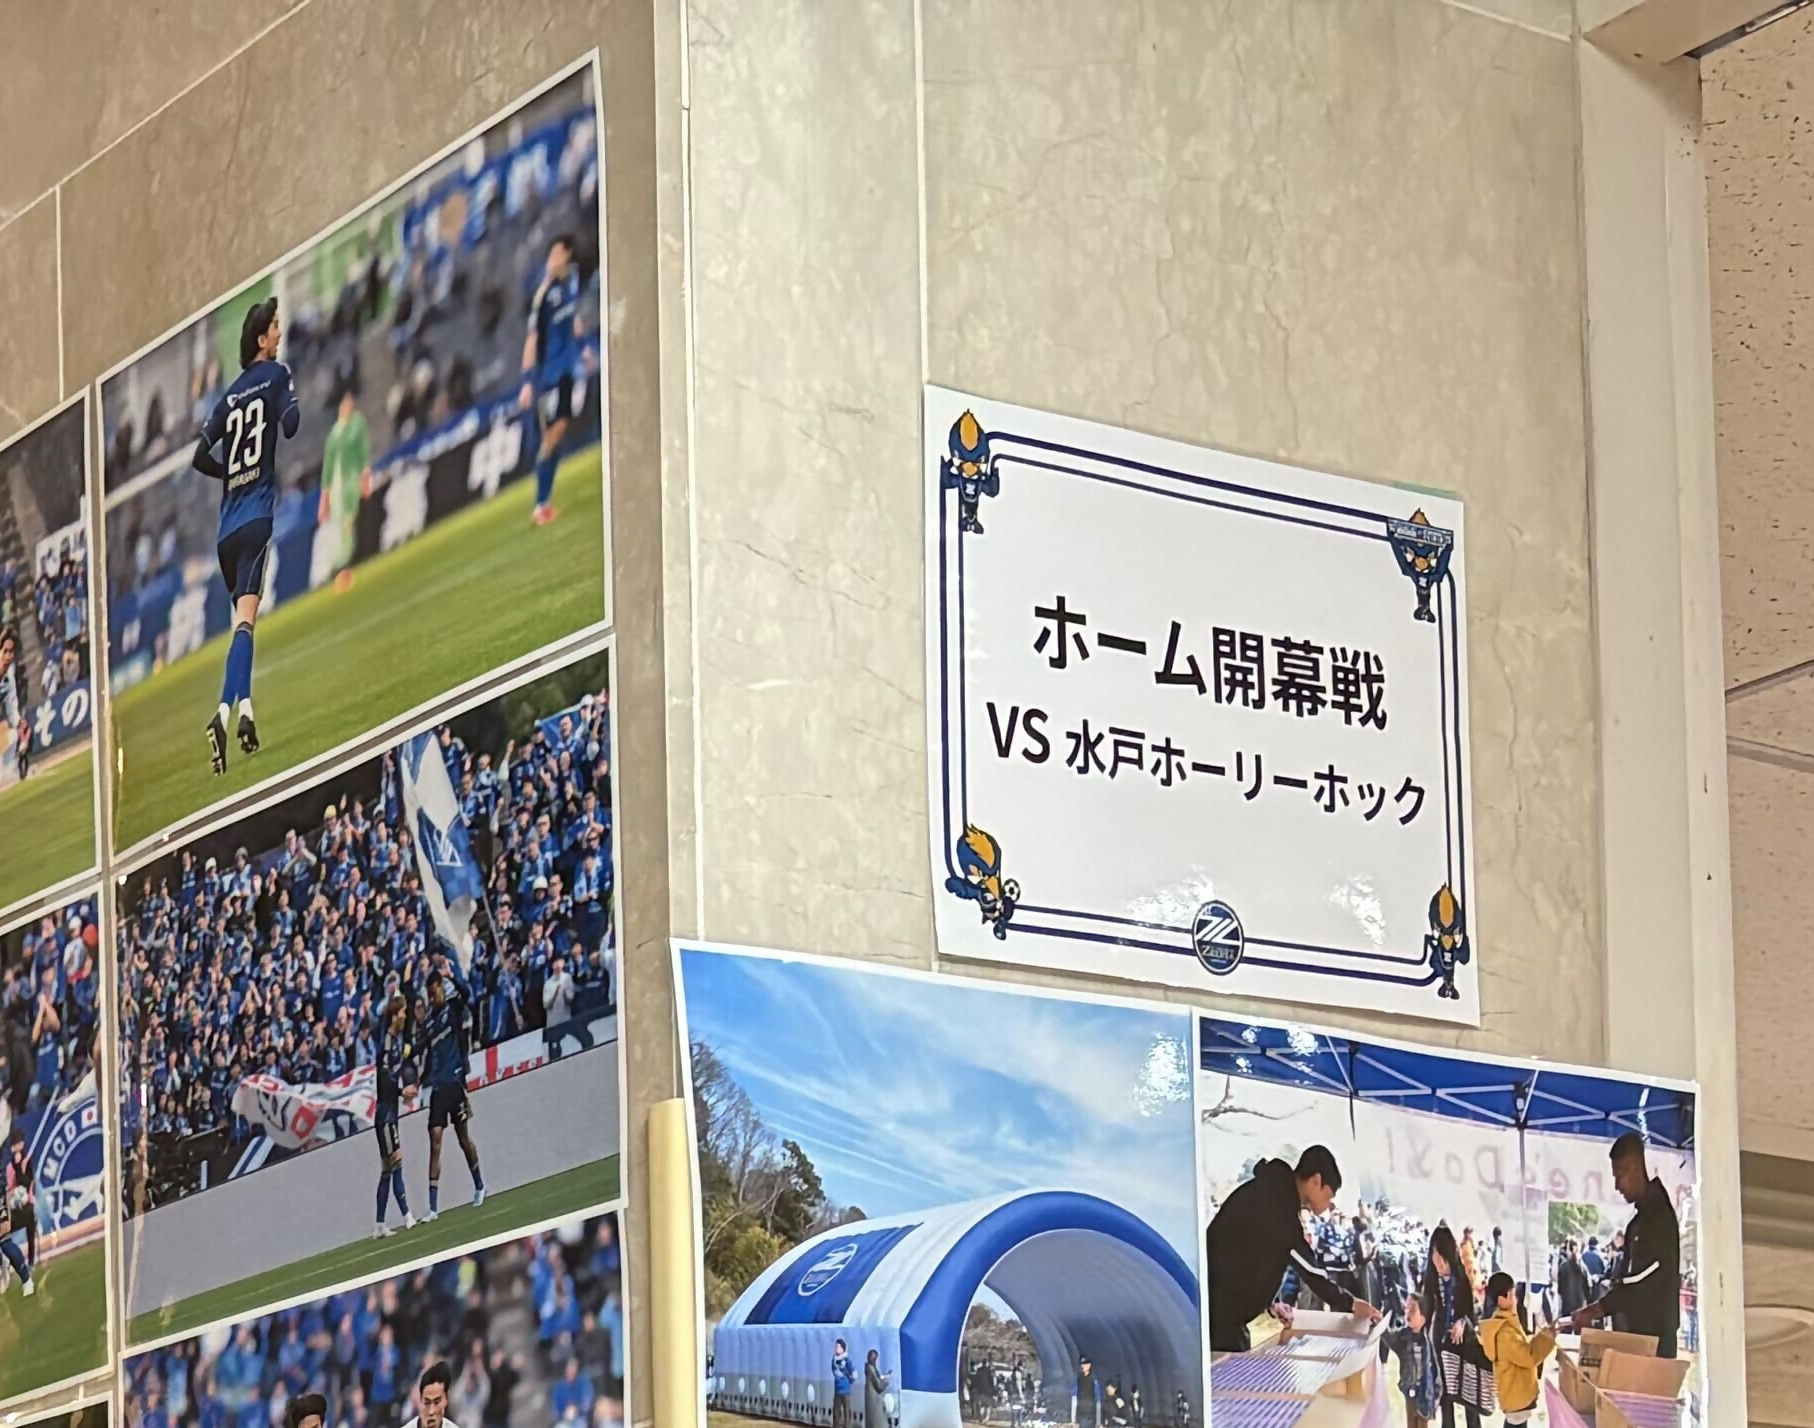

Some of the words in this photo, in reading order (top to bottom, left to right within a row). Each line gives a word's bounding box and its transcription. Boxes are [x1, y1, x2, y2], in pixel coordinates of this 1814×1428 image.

[226, 398, 267, 475] 23
[1033, 595, 1388, 730] ホーム開幕戦
[986, 702, 1051, 763] VS
[1064, 717, 1426, 826] 水戸ホーリーホック
